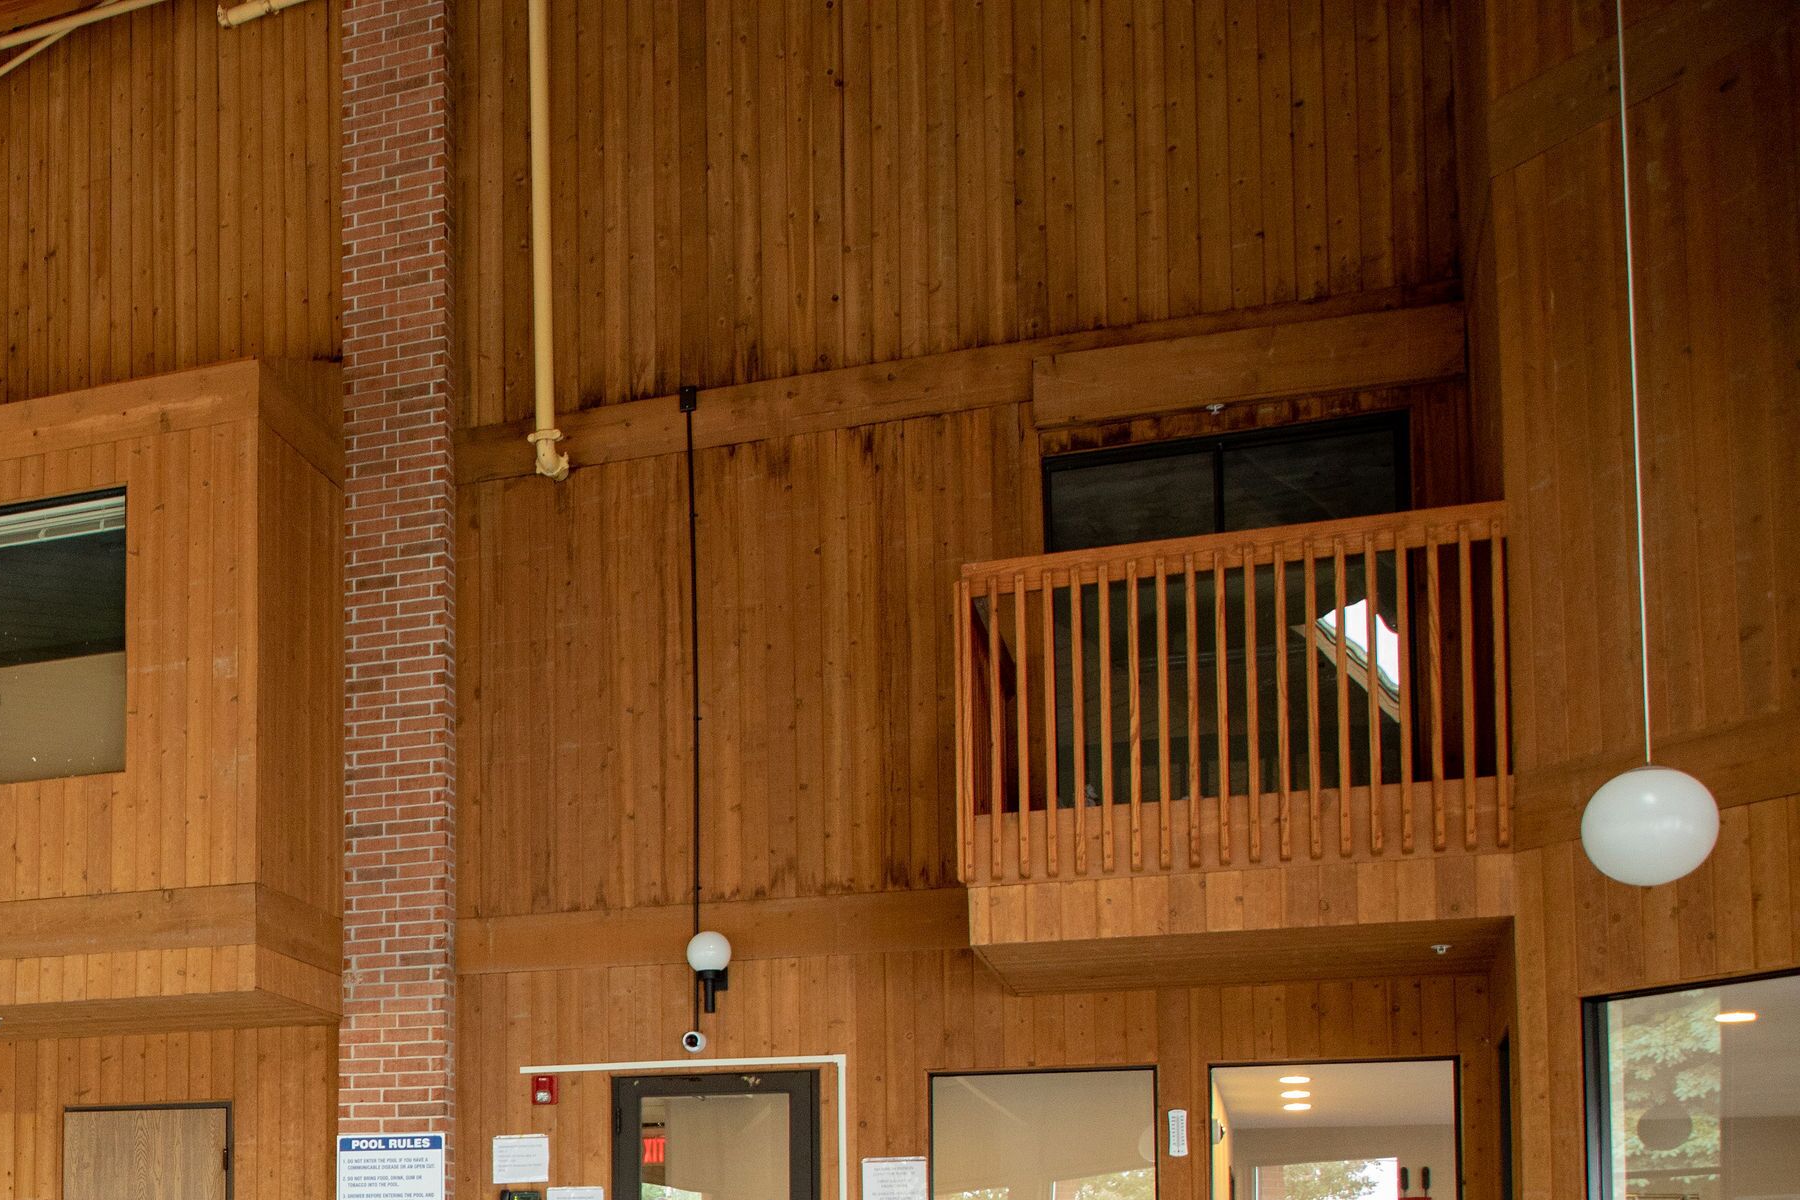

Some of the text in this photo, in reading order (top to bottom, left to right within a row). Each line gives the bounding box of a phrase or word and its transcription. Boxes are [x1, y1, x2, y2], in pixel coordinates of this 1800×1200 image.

[351, 1138, 431, 1149] POOL RULES
[643, 1138, 665, 1163] XIT
